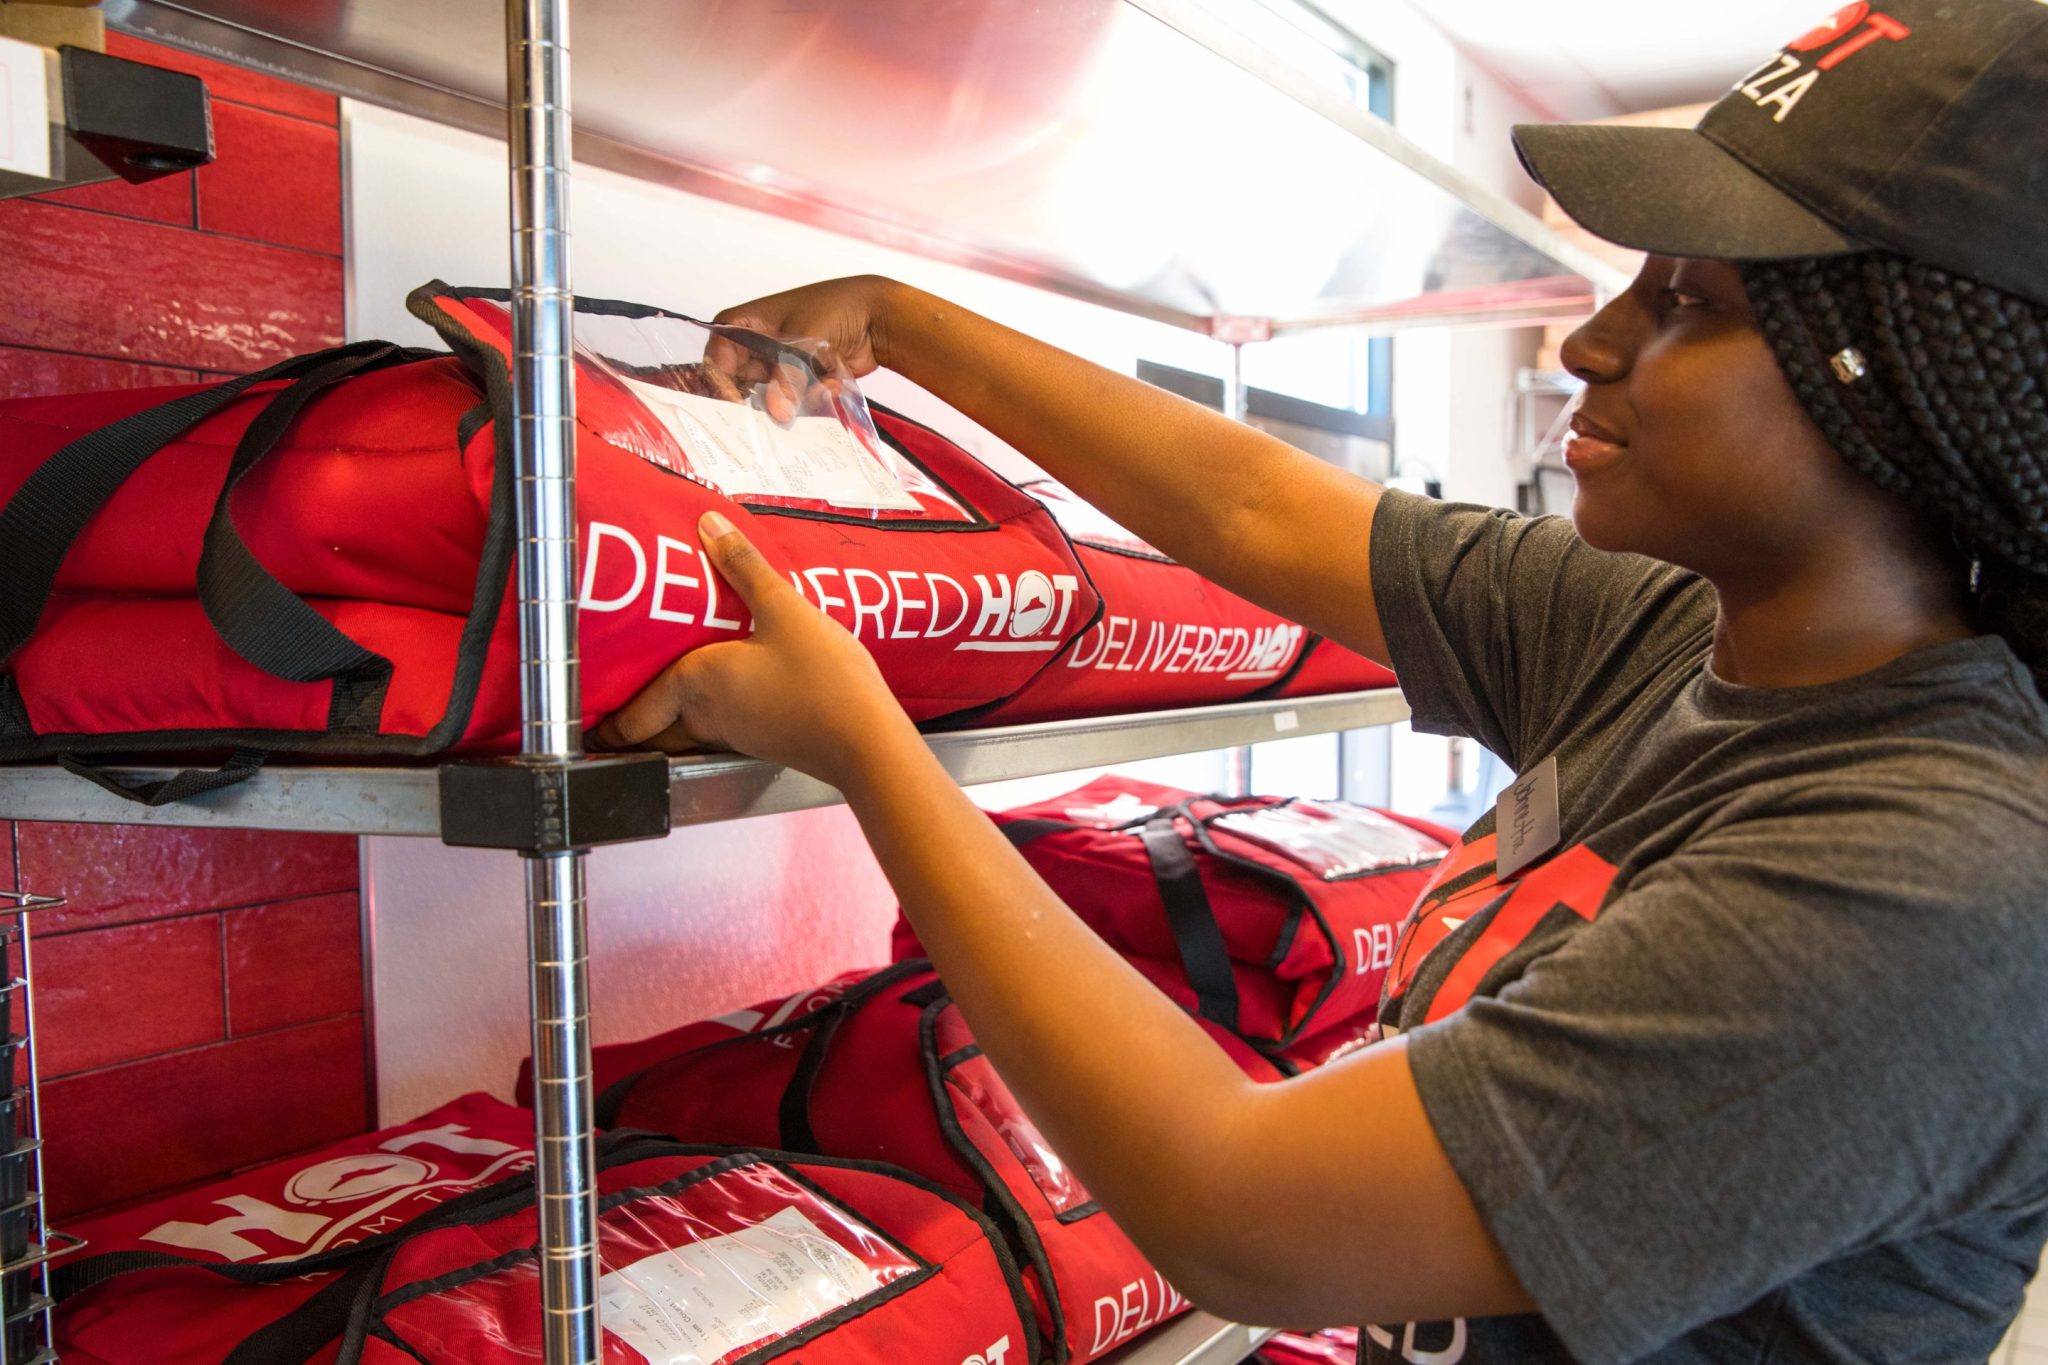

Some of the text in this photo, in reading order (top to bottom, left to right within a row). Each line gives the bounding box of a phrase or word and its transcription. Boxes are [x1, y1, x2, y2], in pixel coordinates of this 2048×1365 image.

[578, 521, 1079, 640] DELERED HOT
[1067, 616, 1304, 673] DELIVERED HOT
[139, 1123, 520, 1262] HOT
[1089, 1269, 1191, 1356] DELIV
